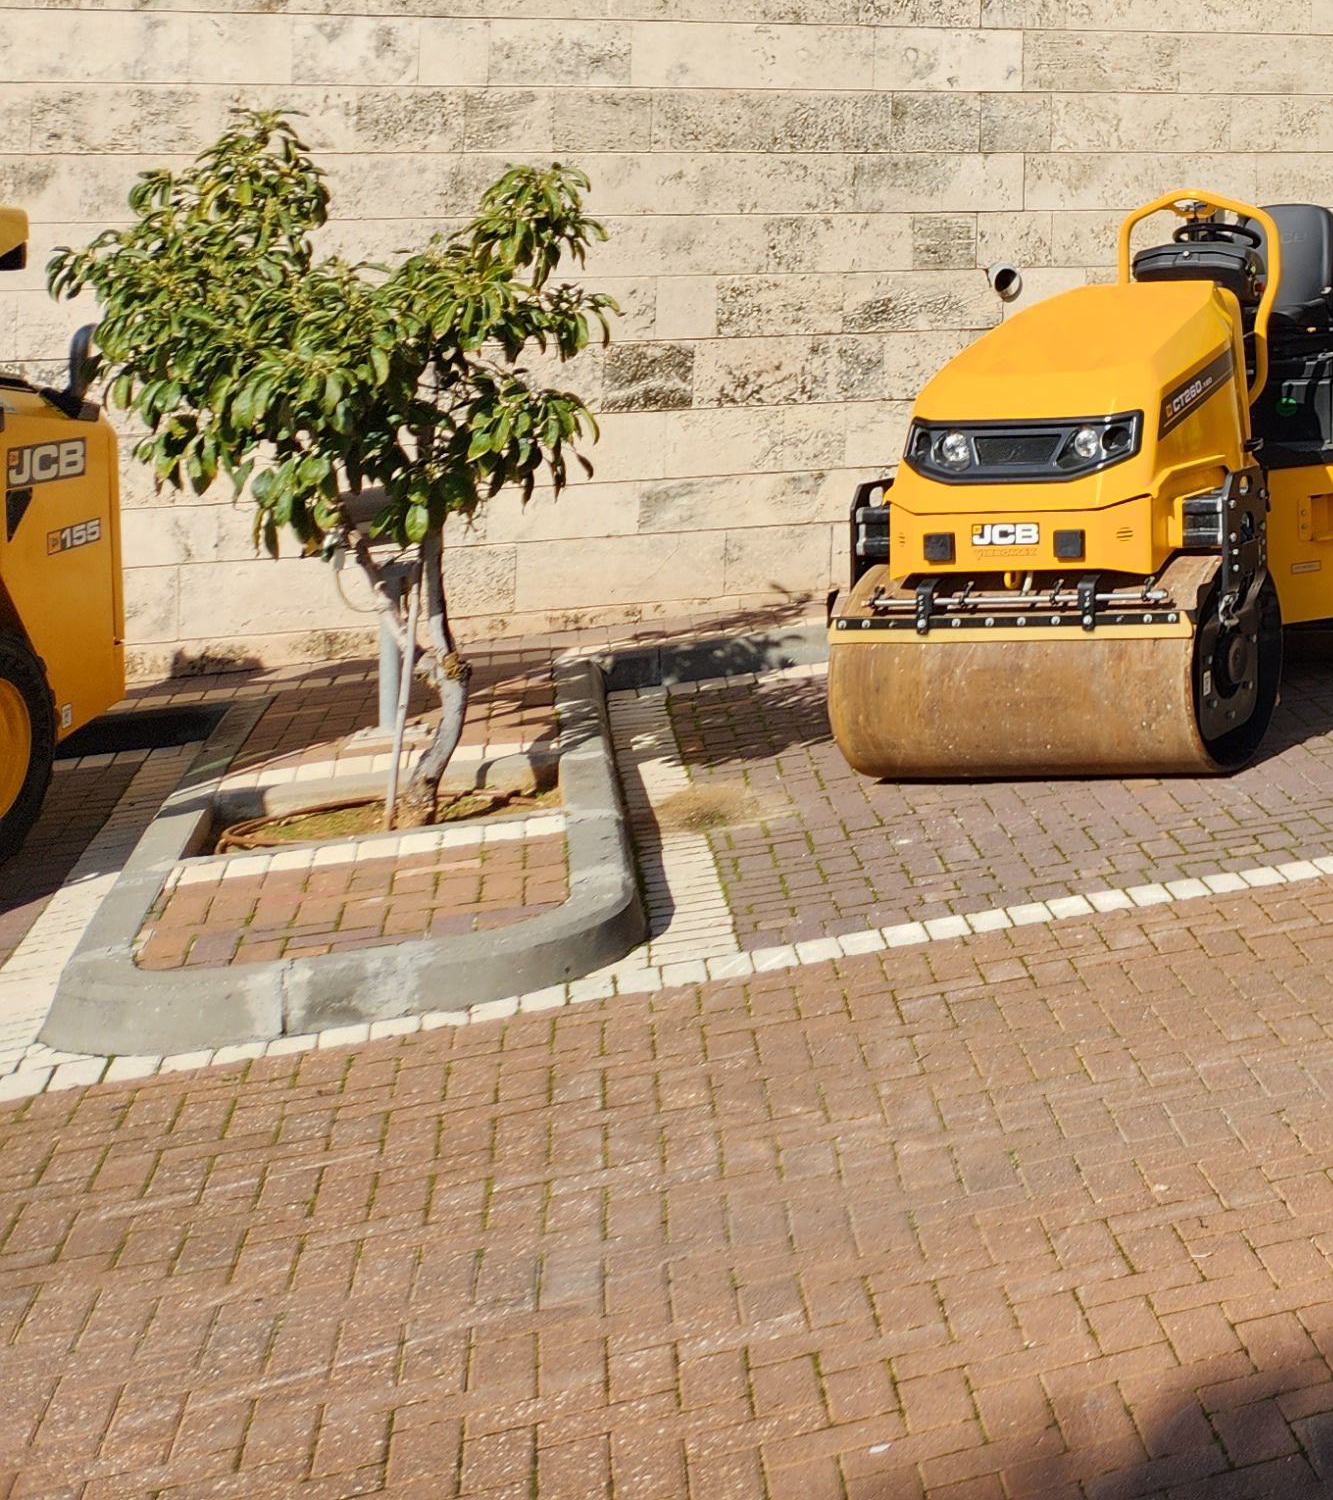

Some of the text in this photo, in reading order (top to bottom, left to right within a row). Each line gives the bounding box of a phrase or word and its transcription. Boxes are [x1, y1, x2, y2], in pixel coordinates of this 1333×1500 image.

[8, 440, 85, 485] JCB
[61, 519, 101, 549] 155
[972, 523, 1039, 546] JCB
